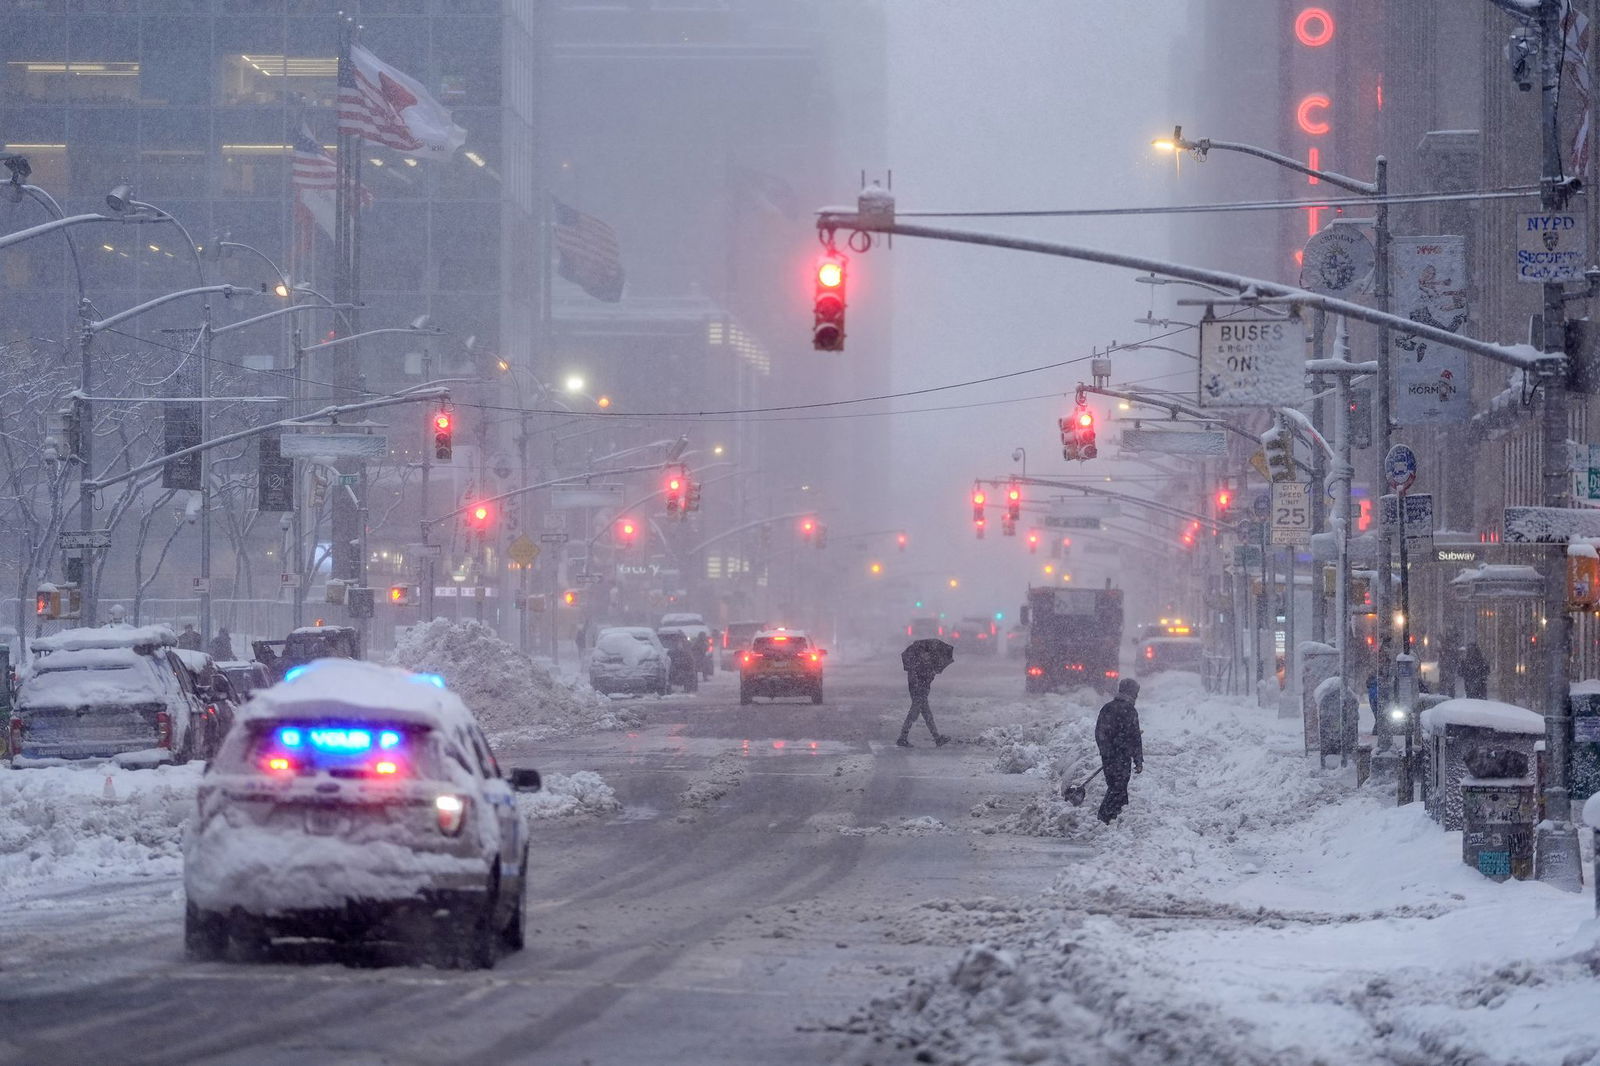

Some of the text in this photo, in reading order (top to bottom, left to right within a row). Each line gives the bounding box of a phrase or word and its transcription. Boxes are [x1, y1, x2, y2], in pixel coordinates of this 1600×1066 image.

[1297, 95, 1330, 266] CIT
[1527, 216, 1575, 231] NYPD
[1220, 324, 1283, 341] BUSES
[1276, 508, 1305, 525] 25
[1438, 551, 1475, 562] Subway
